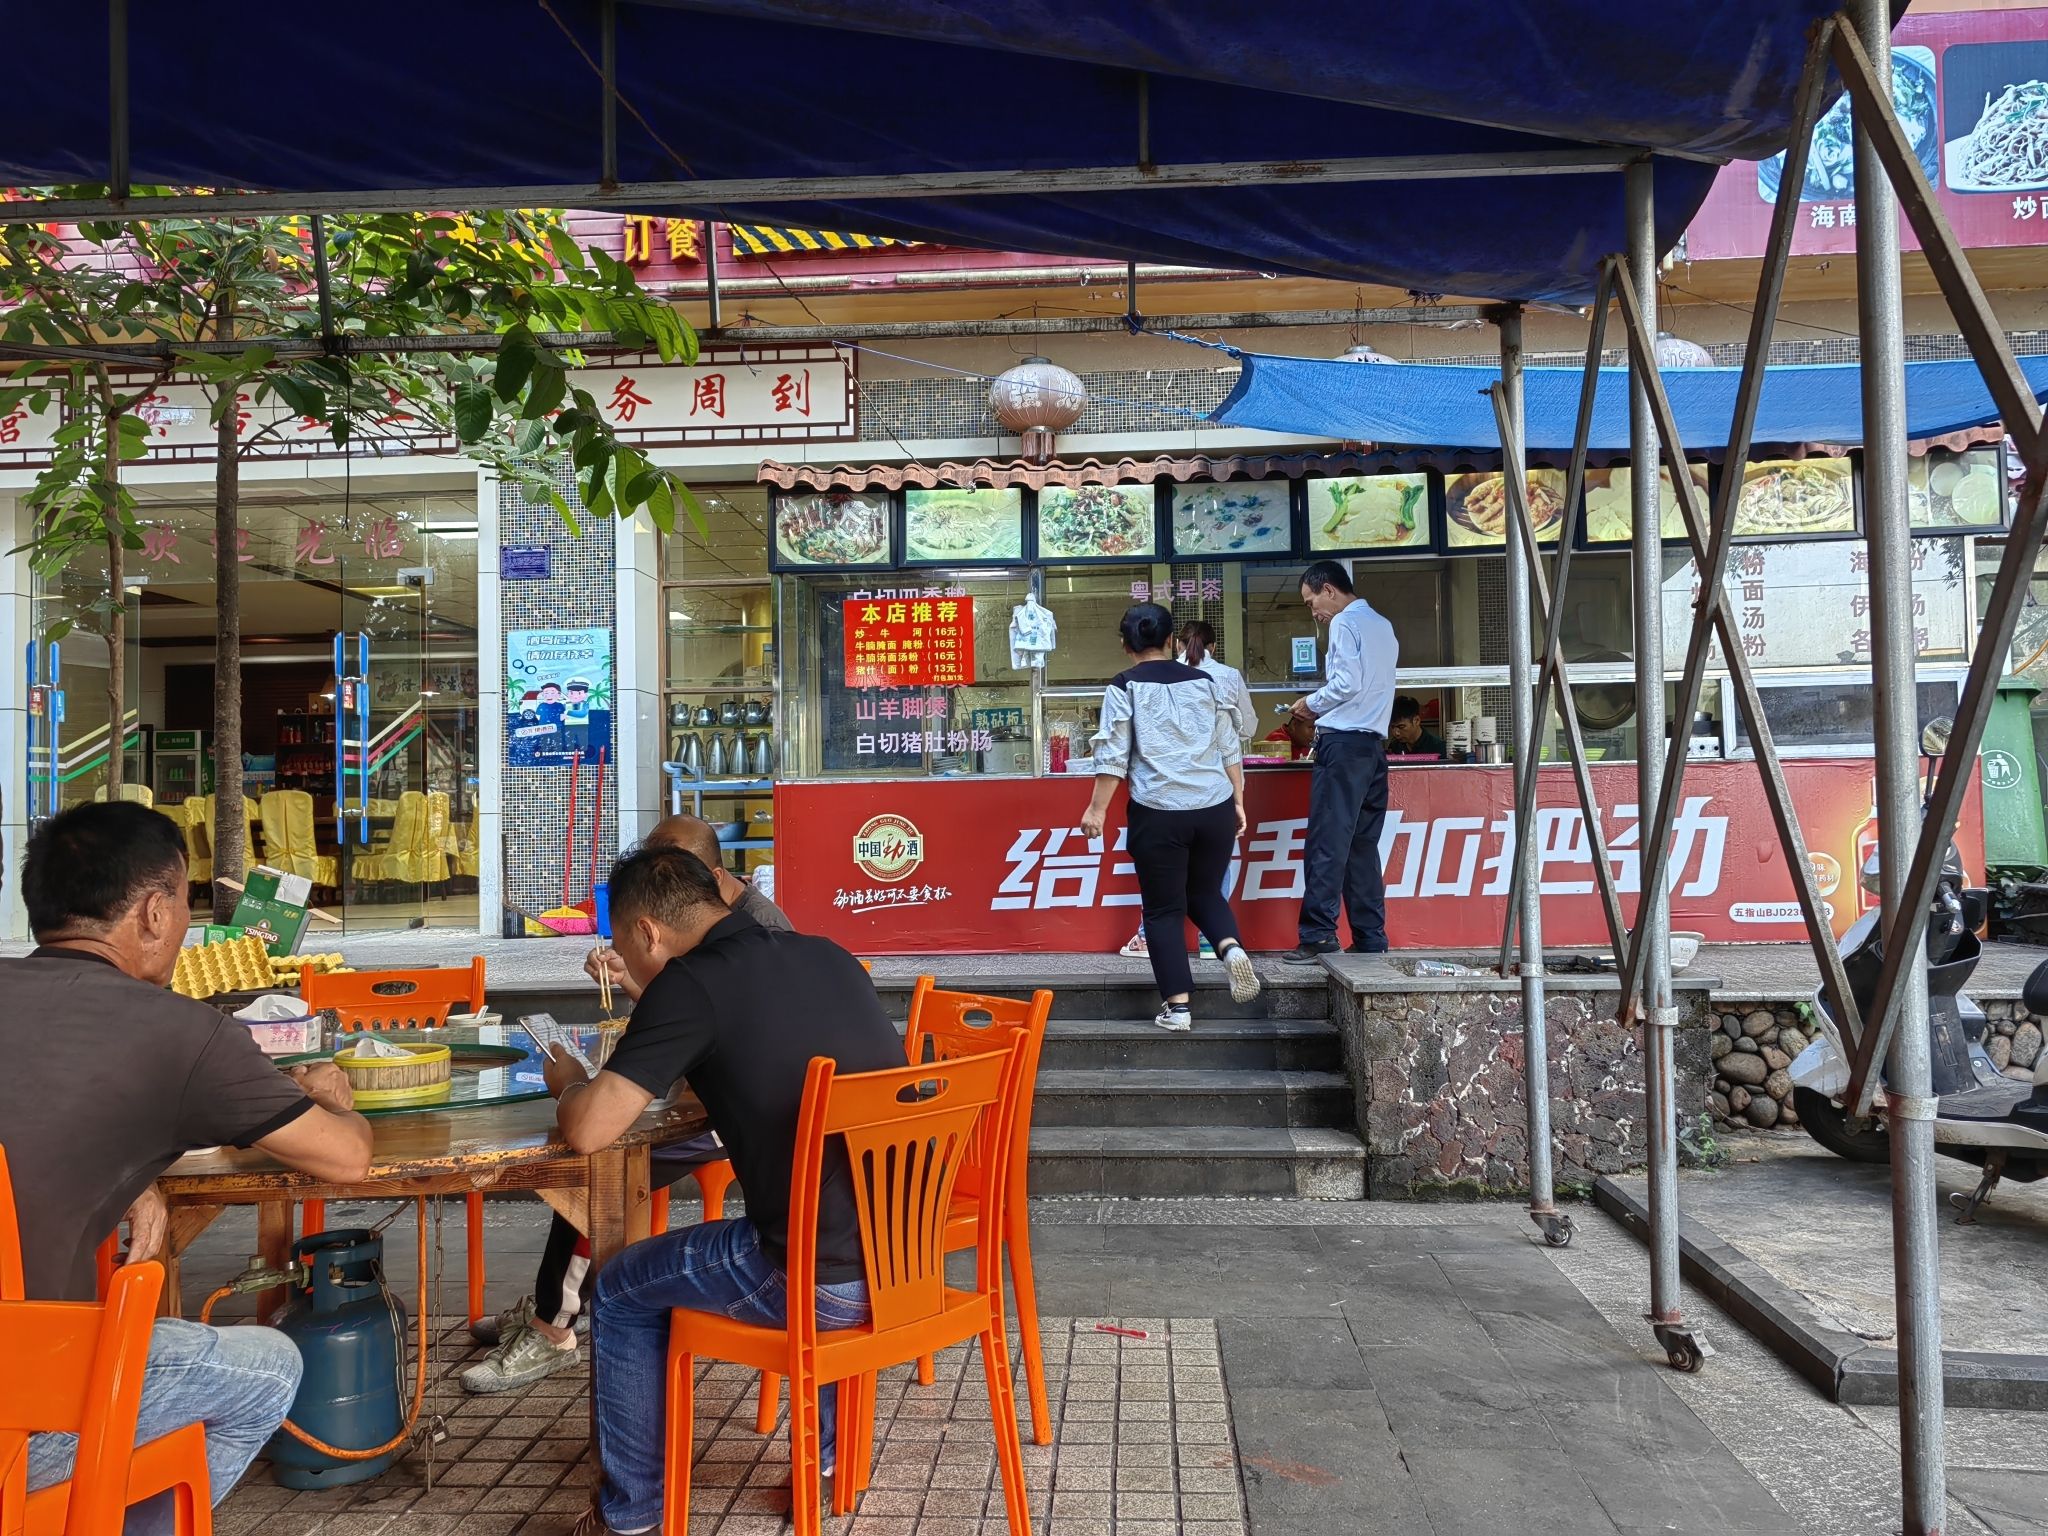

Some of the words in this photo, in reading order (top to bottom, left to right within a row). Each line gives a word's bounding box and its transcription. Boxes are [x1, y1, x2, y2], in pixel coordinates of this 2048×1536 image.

[624, 213, 697, 262] 订餐
[545, 368, 811, 422] 务周到
[1129, 578, 1223, 602] 粤式早茶
[861, 601, 958, 624] 本店推荐
[855, 696, 947, 721] 山羊脚煲
[976, 711, 1019, 729] 熟砧板
[856, 729, 992, 755] 白切猪肚粉肠
[859, 833, 918, 864] 中国劲酒
[1734, 907, 1831, 918] 五指山BJD233
[244, 926, 278, 942] TSINGTAO
